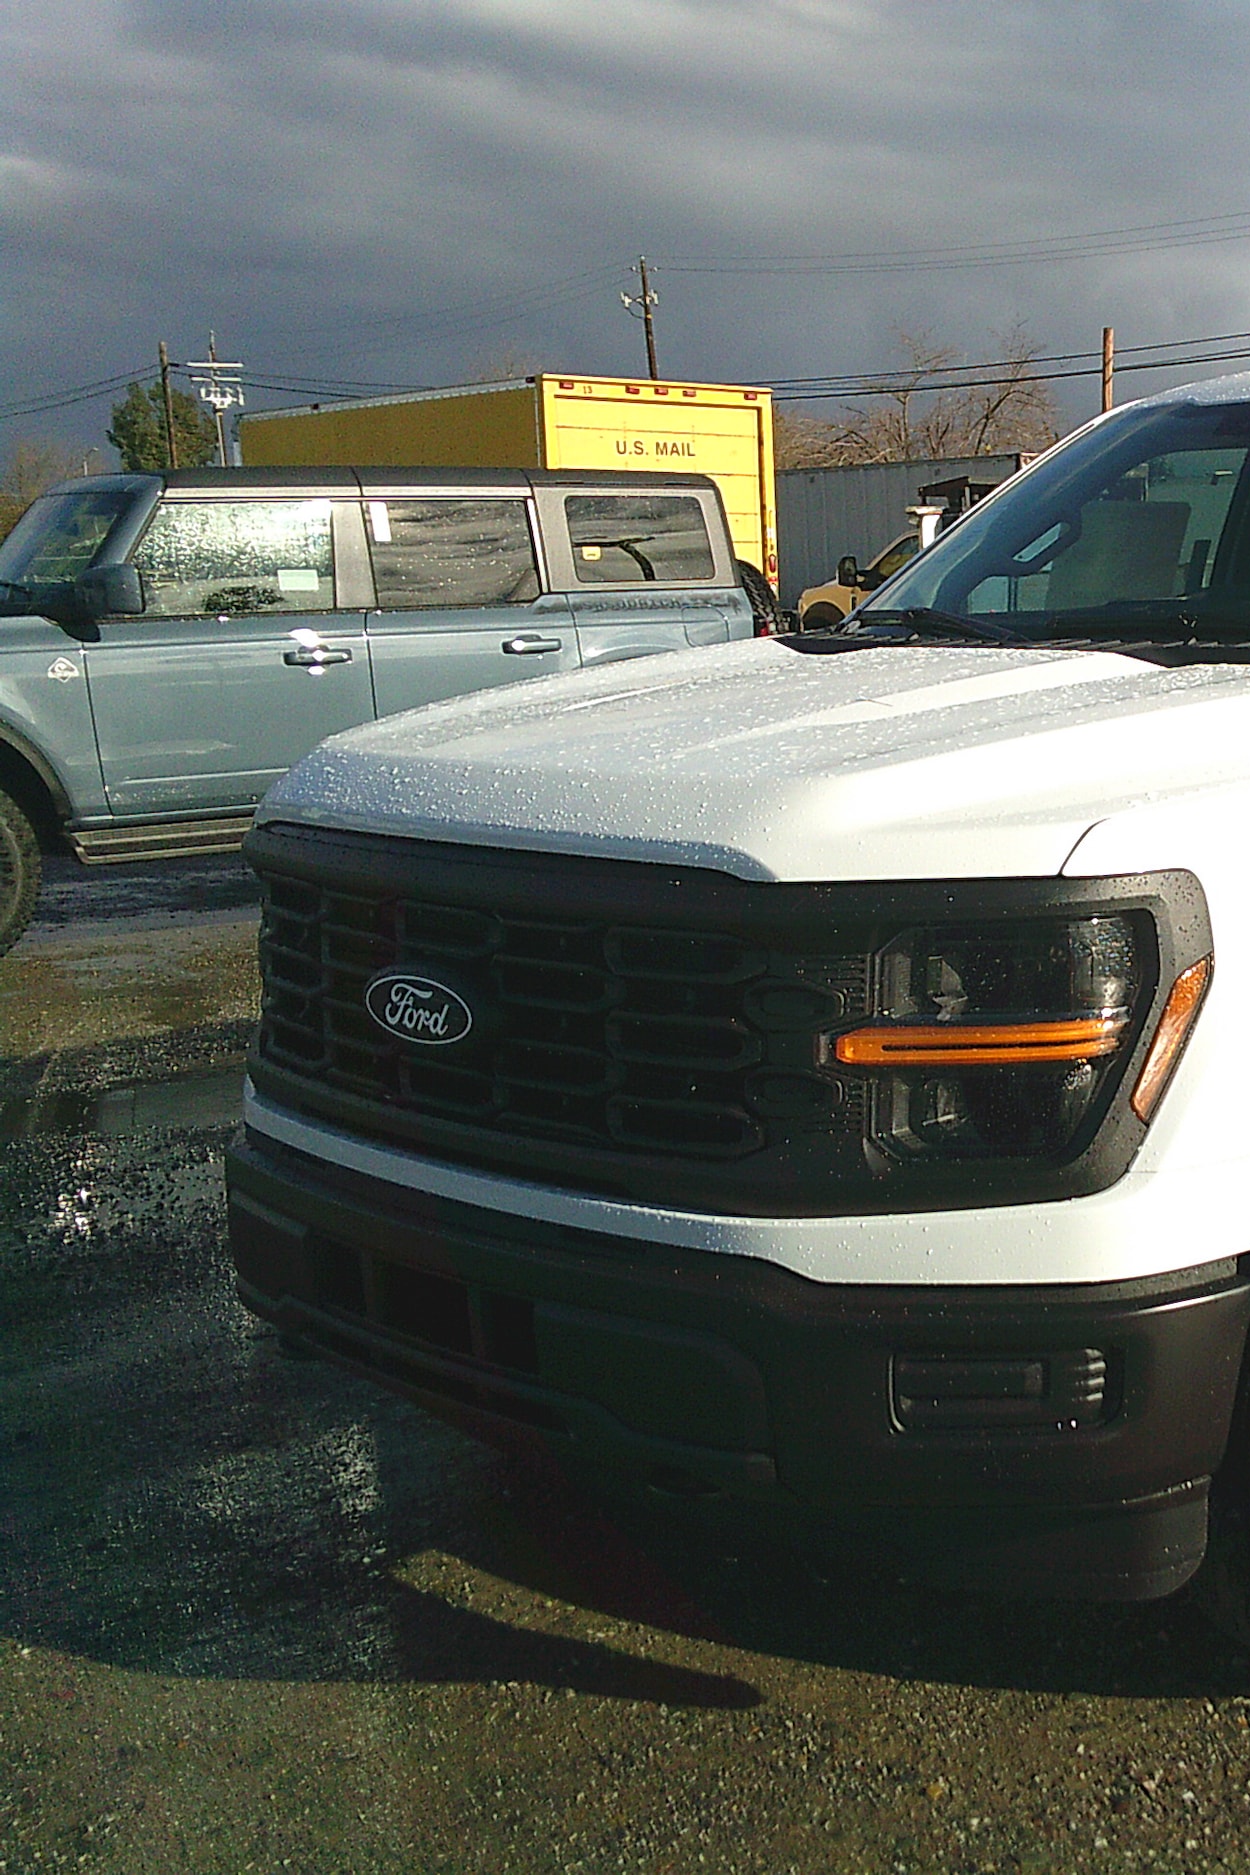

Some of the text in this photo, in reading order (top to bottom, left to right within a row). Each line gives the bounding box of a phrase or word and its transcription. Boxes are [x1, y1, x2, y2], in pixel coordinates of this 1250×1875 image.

[615, 440, 696, 457] U.S. MAIL
[385, 982, 449, 1036] Ford
